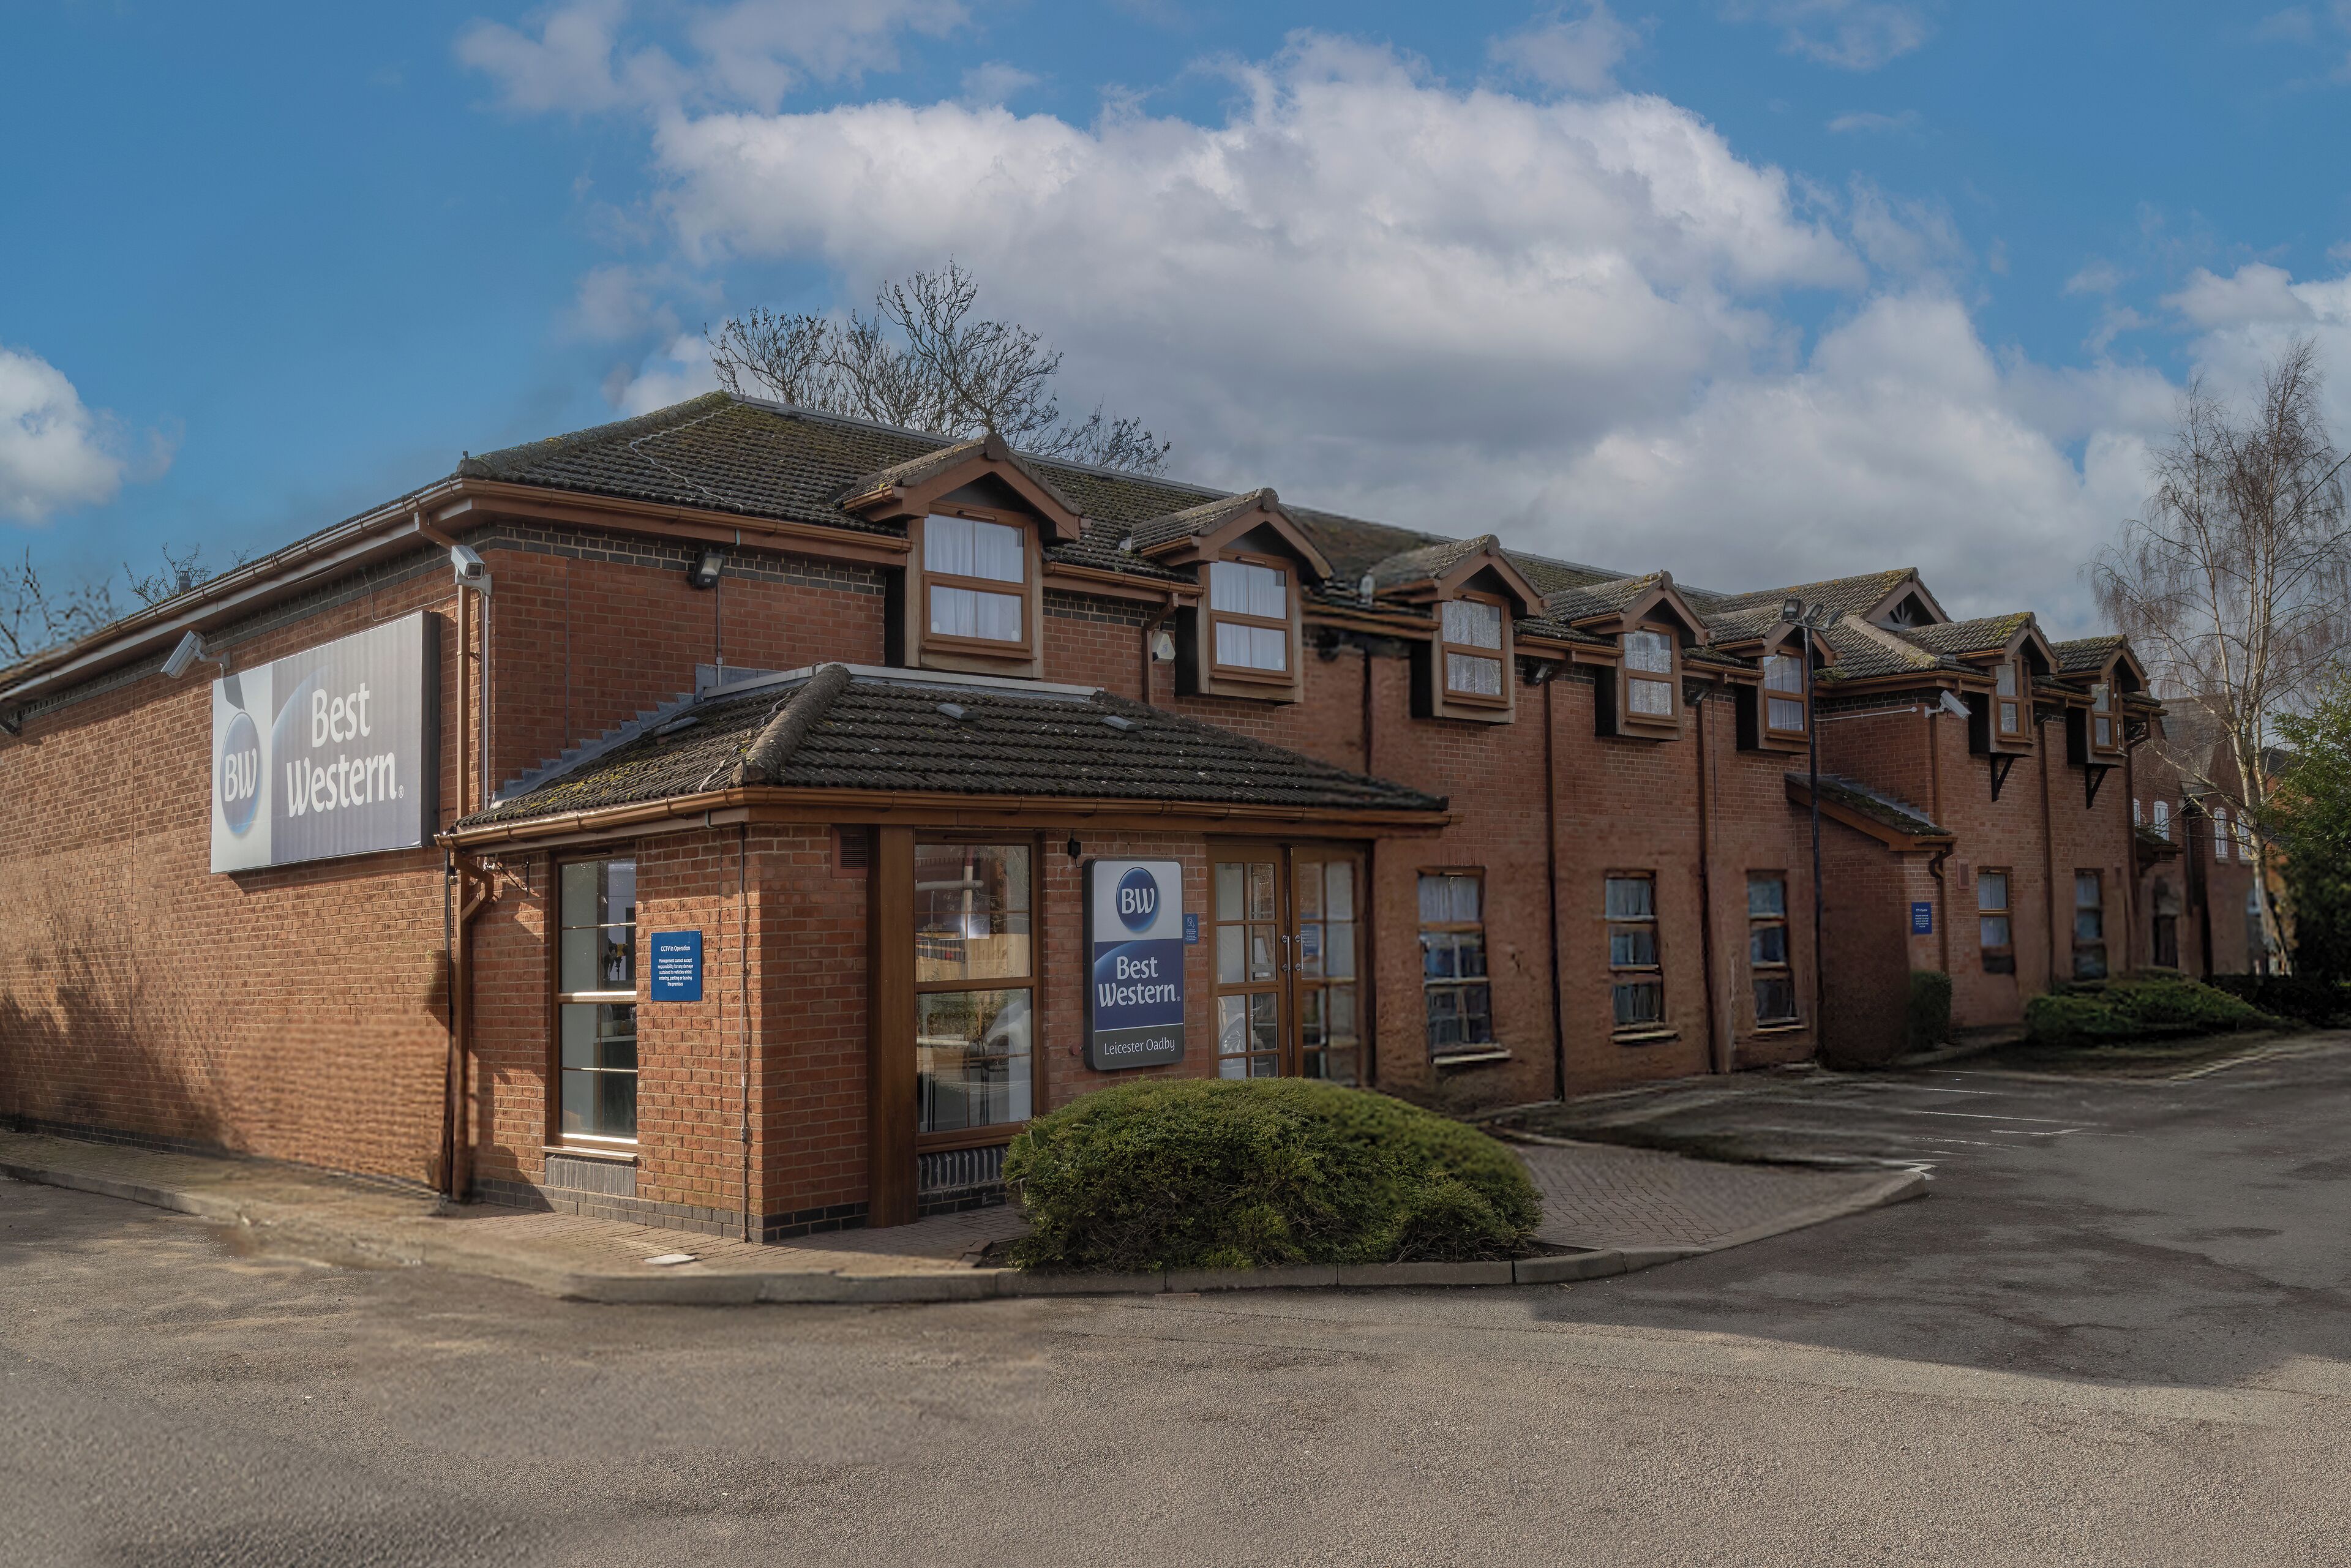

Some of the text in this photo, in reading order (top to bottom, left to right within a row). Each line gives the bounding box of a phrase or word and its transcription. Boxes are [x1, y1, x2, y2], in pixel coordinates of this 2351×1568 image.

[312, 683, 370, 748] Best
[225, 748, 257, 802] BW
[1122, 887, 1155, 914] BW
[1116, 956, 1159, 980] Best
[1104, 1038, 1176, 1056] Leicester Oadby
